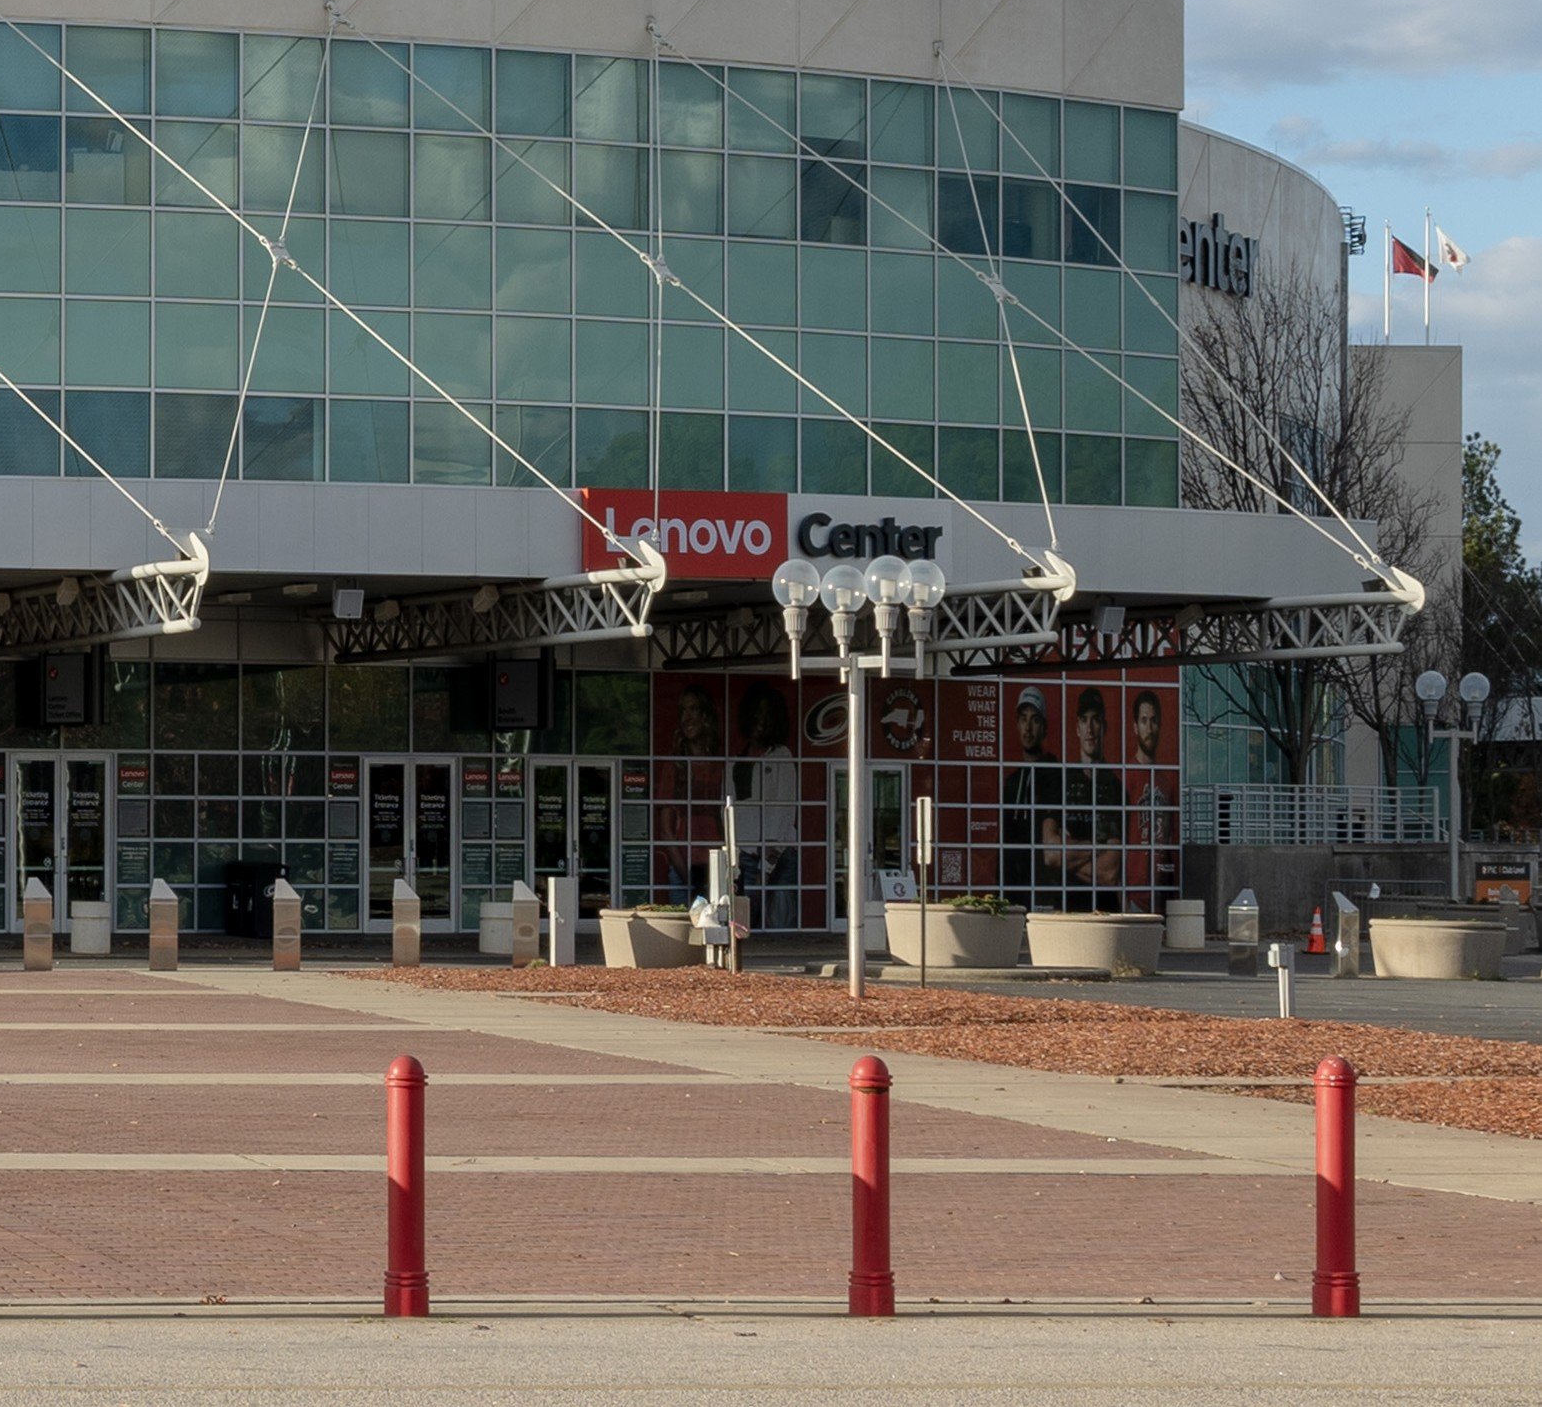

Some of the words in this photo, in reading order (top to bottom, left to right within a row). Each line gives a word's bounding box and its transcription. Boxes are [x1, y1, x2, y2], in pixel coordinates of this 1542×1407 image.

[1180, 211, 1259, 298] enter
[798, 512, 943, 560] Center
[968, 685, 996, 697] WEAR
[968, 700, 996, 712] WHAT
[976, 715, 996, 727] THE
[952, 730, 996, 743] PLAYERS
[965, 745, 996, 758] WEAR.
[120, 770, 146, 778] Lenovo
[331, 772, 355, 780] Lenovo
[624, 775, 646, 783] Lenovo
[374, 794, 399, 802] Ticketing
[420, 794, 446, 802] Ticketing
